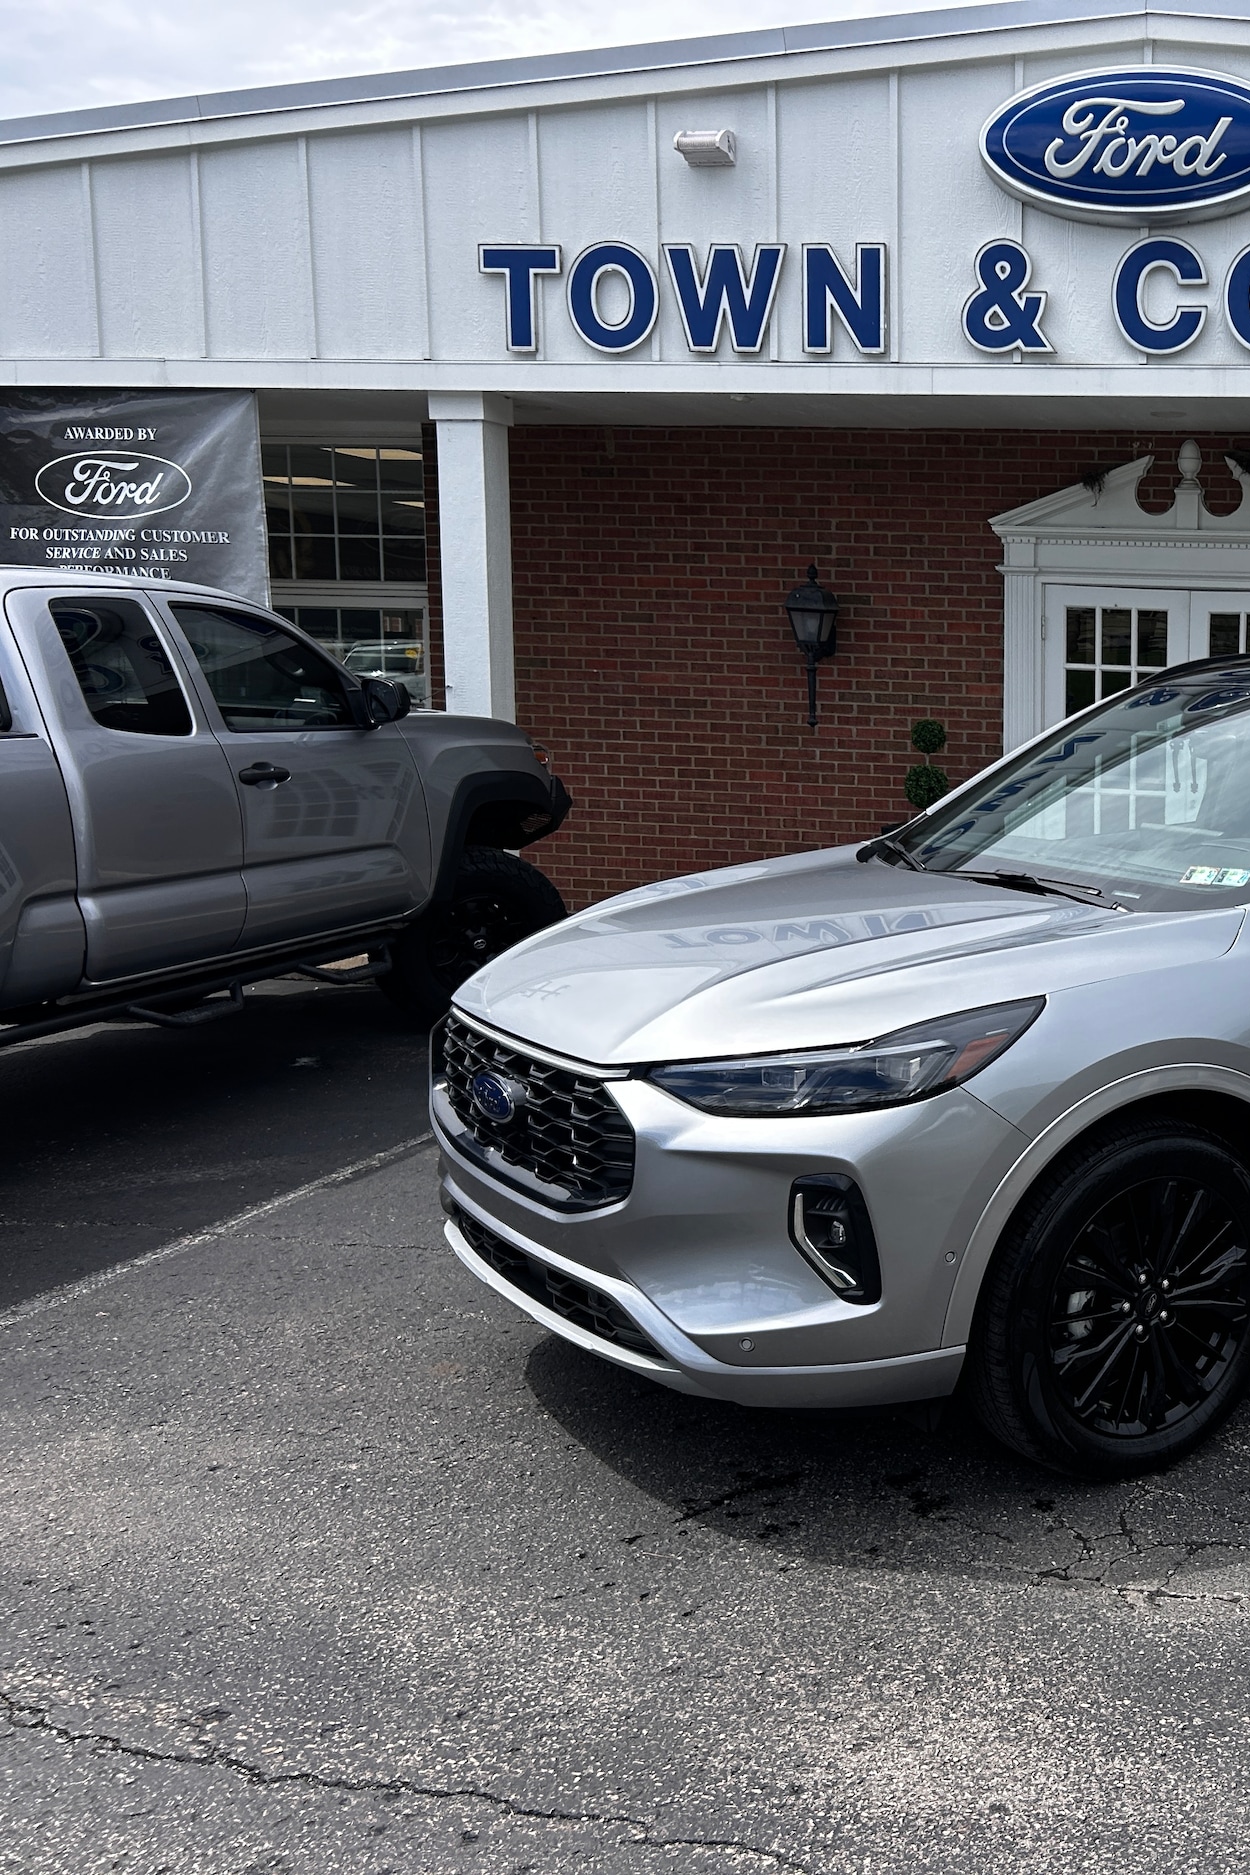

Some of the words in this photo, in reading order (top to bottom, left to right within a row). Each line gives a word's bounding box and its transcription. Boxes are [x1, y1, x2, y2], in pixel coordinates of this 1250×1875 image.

[1044, 97, 1234, 179] Ford
[478, 241, 888, 355] TOWN
[961, 237, 1058, 355] &
[63, 426, 134, 440] AWARDED
[137, 427, 157, 441] BY
[64, 459, 164, 505] Ford
[9, 527, 39, 540] FOR
[42, 528, 136, 542] OUTSTANDING
[140, 529, 231, 544] CUSTOMER
[45, 547, 101, 559] SERVICE
[104, 547, 136, 560] AND
[140, 548, 188, 562] SALES
